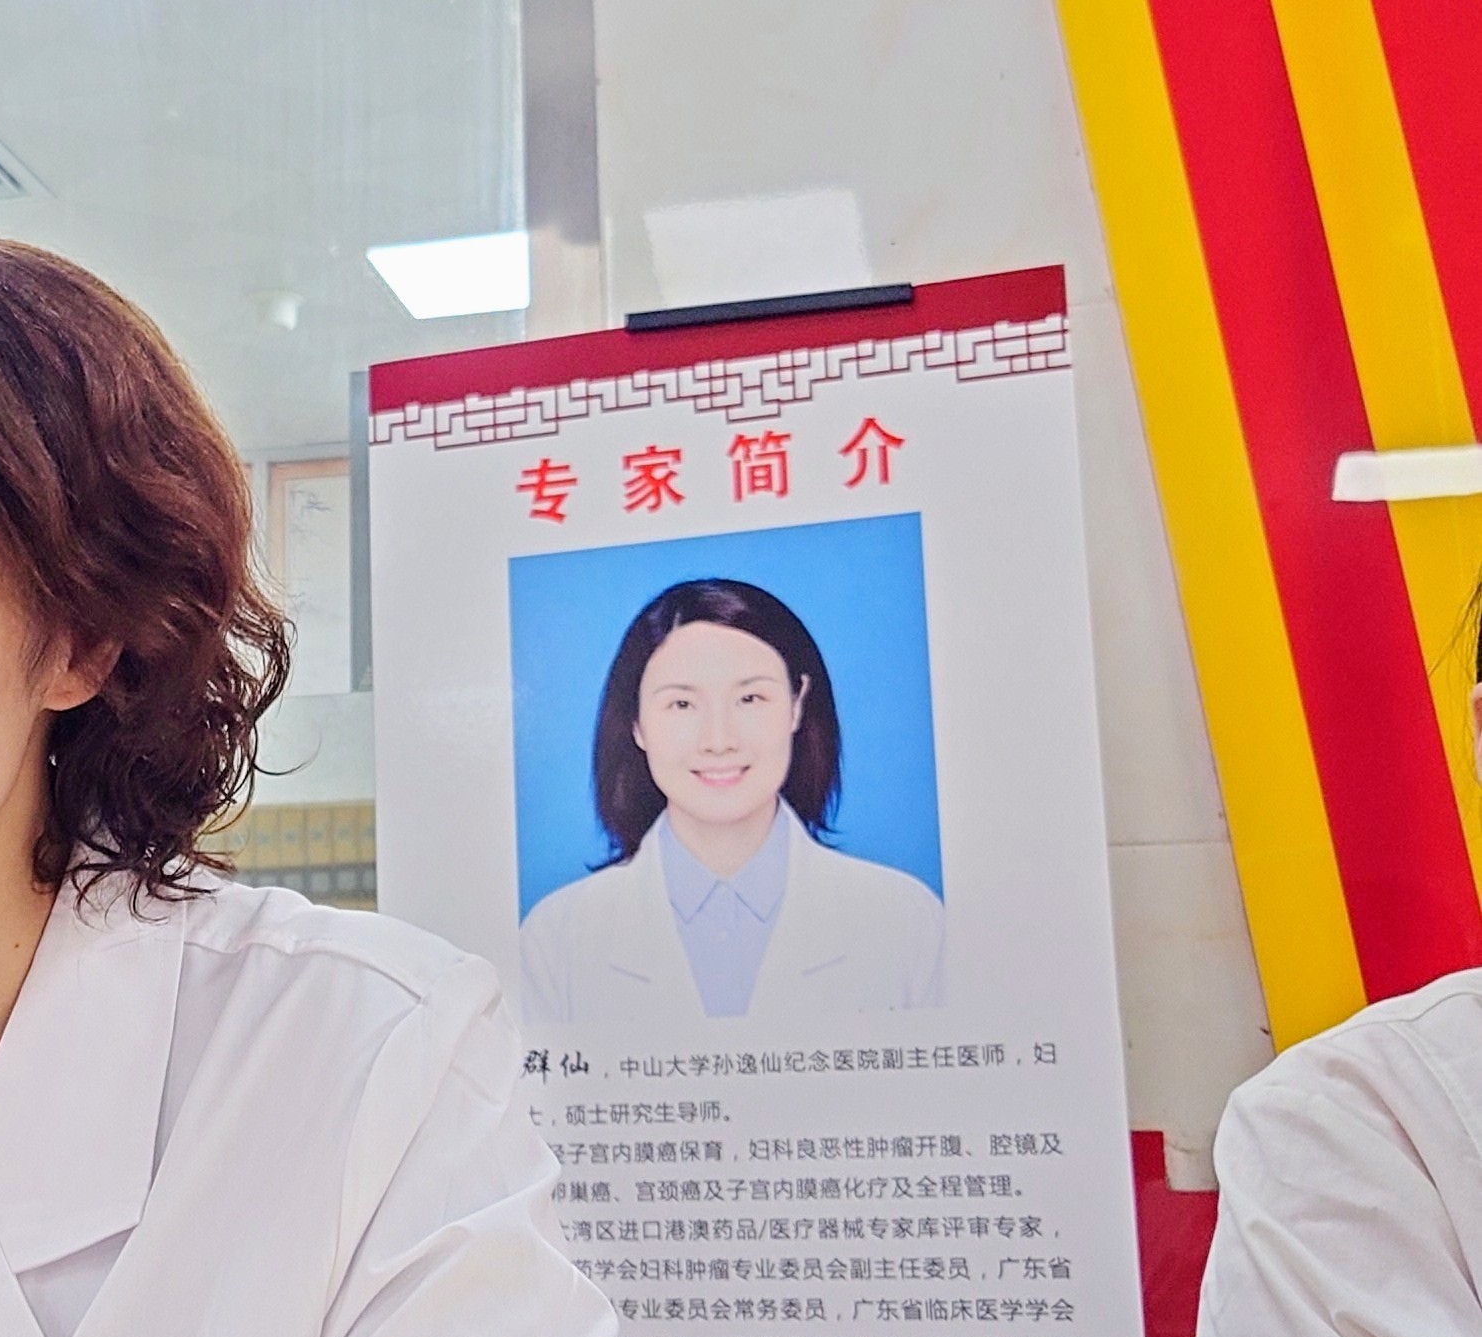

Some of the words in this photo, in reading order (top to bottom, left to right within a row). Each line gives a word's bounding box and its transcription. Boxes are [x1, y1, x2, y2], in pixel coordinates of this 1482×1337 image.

[515, 416, 905, 524] 专家简介
[610, 1297, 1075, 1323] 专业委员会常务委员，广东省临床医学学会
